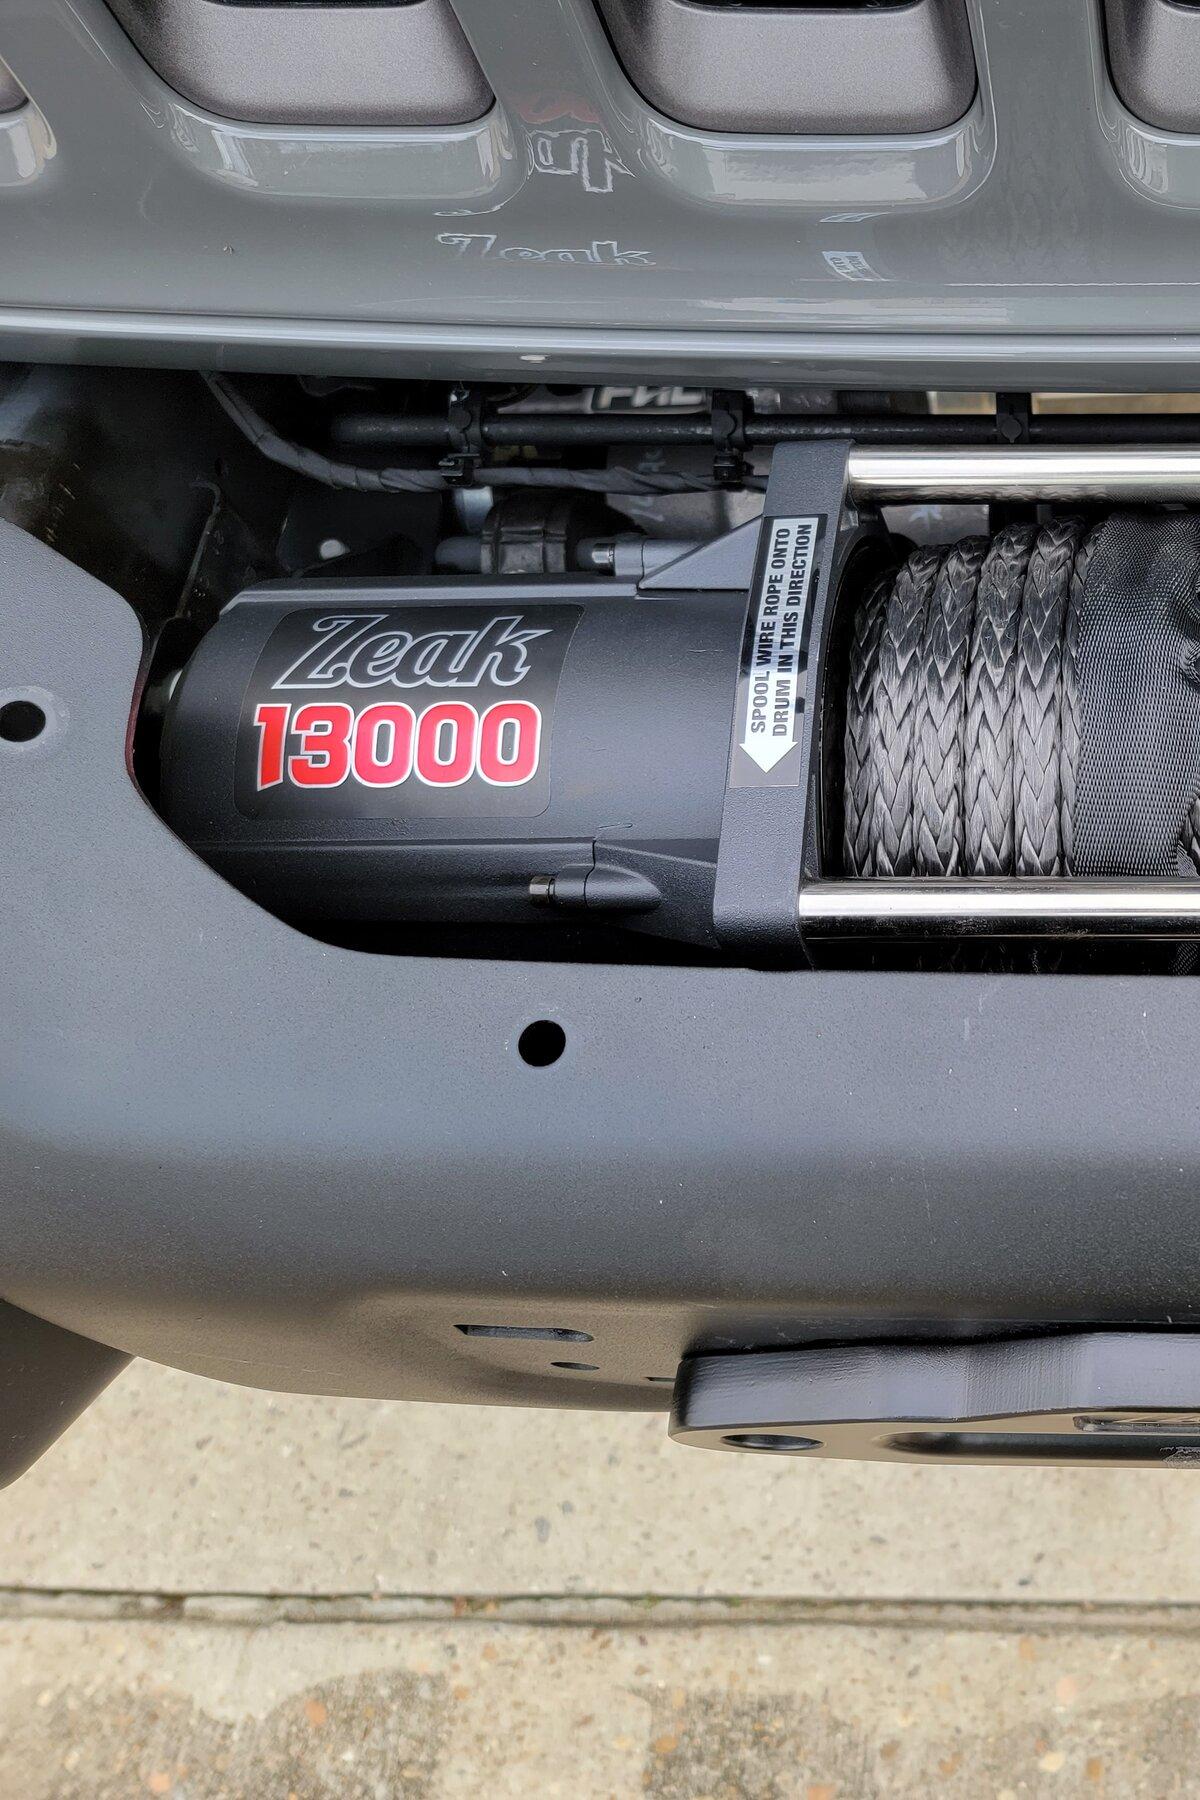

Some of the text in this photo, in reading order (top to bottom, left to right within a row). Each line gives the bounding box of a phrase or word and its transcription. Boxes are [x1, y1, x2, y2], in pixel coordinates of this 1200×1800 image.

[271, 614, 553, 689] Zeak
[751, 528, 790, 733] SPOOL WIRE ROPE ONTO
[772, 524, 812, 737] DRUM IN THIS DIRECTION
[253, 700, 542, 792] 13000
